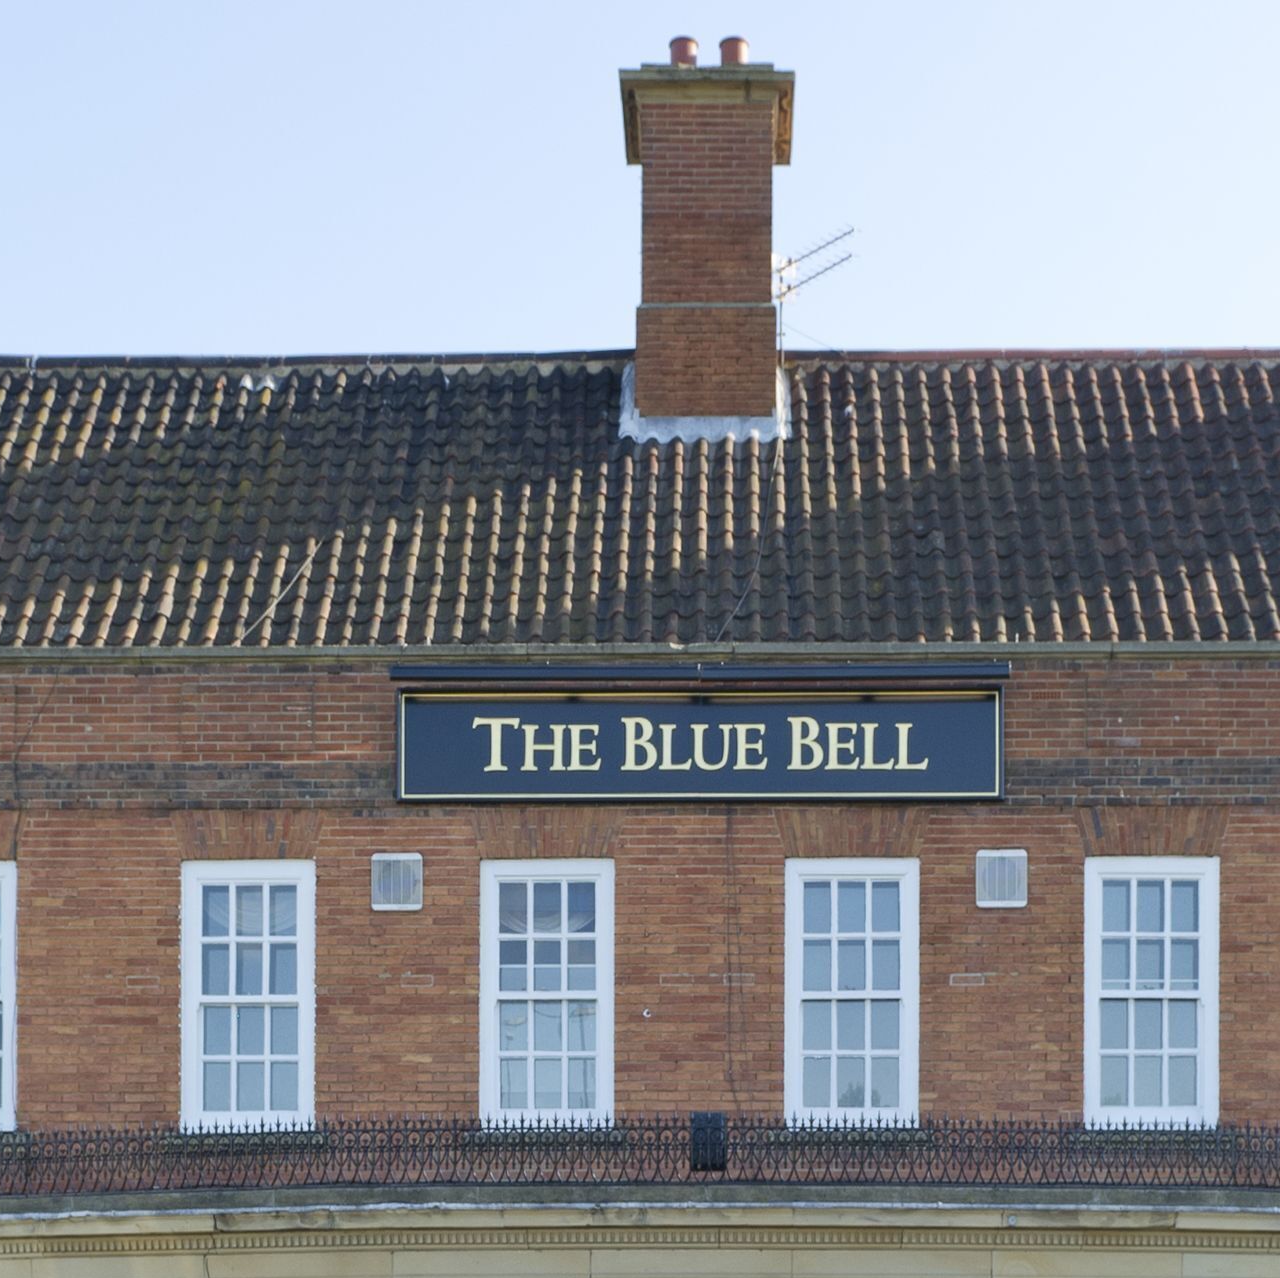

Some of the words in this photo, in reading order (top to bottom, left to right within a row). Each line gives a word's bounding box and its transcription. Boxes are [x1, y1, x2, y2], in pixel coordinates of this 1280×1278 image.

[472, 717, 601, 772] THE
[621, 717, 768, 770] BLUE
[787, 716, 929, 770] BELL
